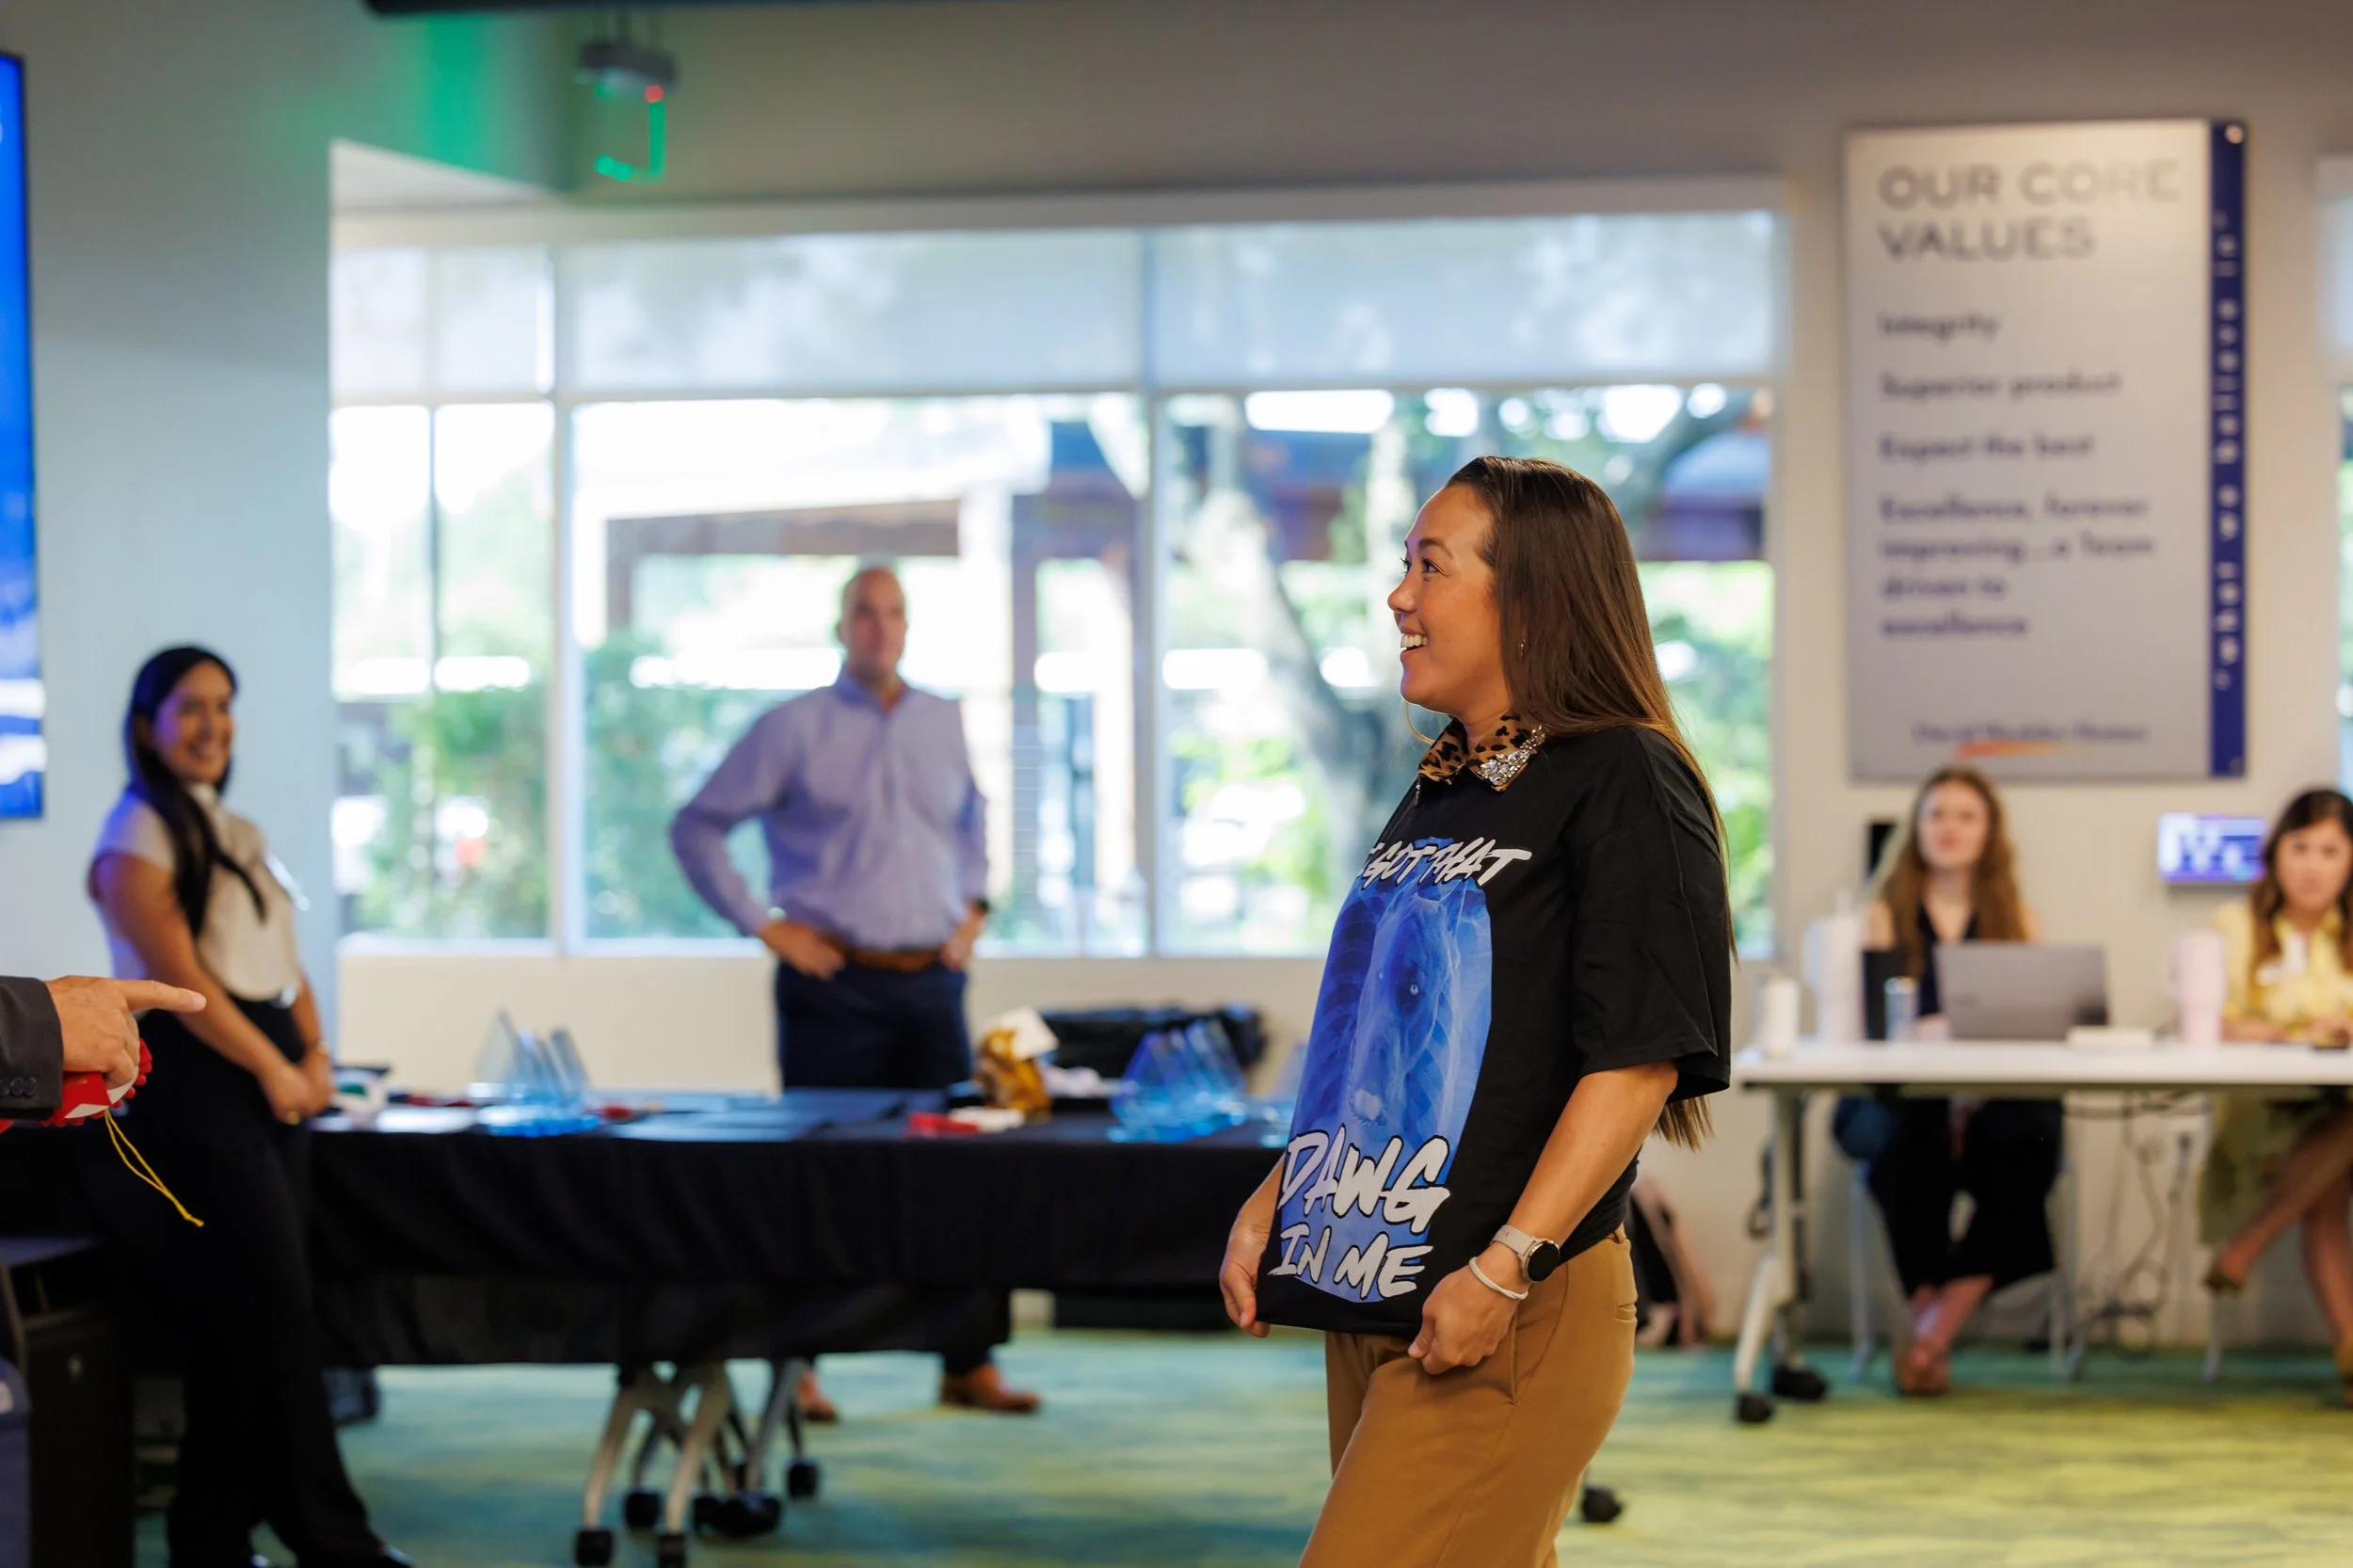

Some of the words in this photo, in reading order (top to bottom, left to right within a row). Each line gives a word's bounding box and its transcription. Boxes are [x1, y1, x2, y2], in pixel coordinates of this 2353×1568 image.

[1880, 166, 2002, 210] OUR
[2020, 160, 2179, 204] CORE
[1880, 216, 2096, 261] VALUES
[1277, 1126, 1450, 1233] DAWG
[1268, 1223, 1332, 1283] IN
[1334, 1232, 1433, 1300] ME
